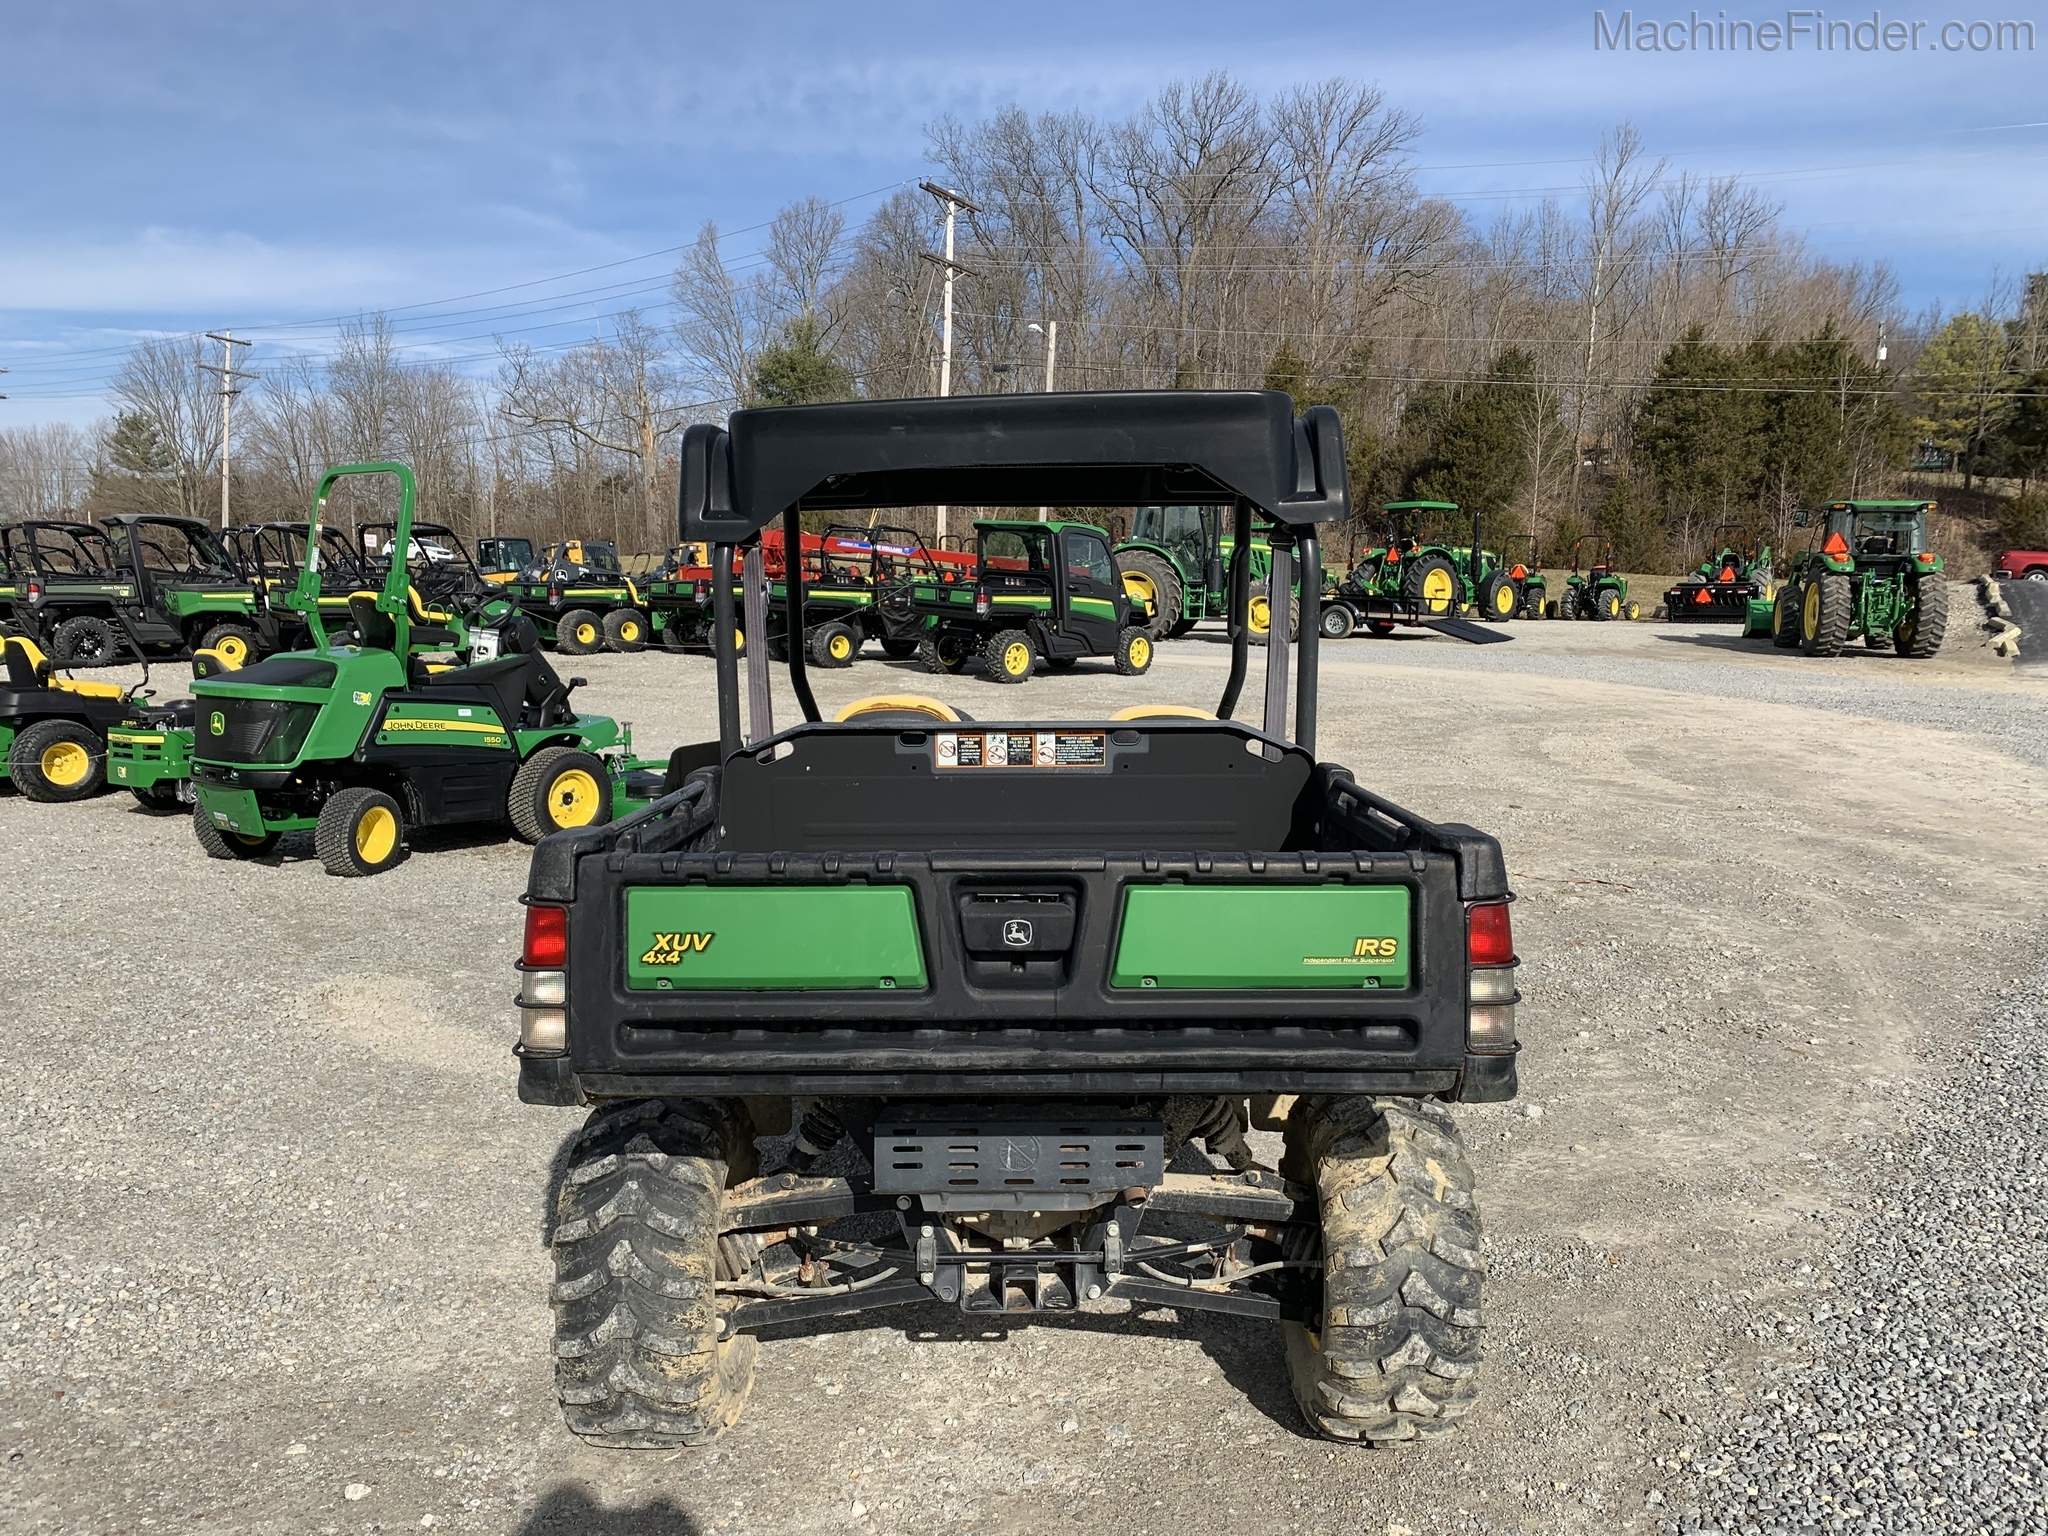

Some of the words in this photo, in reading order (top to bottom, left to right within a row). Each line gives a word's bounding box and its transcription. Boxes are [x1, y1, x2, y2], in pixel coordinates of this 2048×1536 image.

[388, 721, 414, 730] JOHN
[415, 721, 446, 730] DEERE
[652, 933, 713, 952] XUV
[1354, 938, 1398, 956] IRS
[641, 951, 681, 964] 4x4
